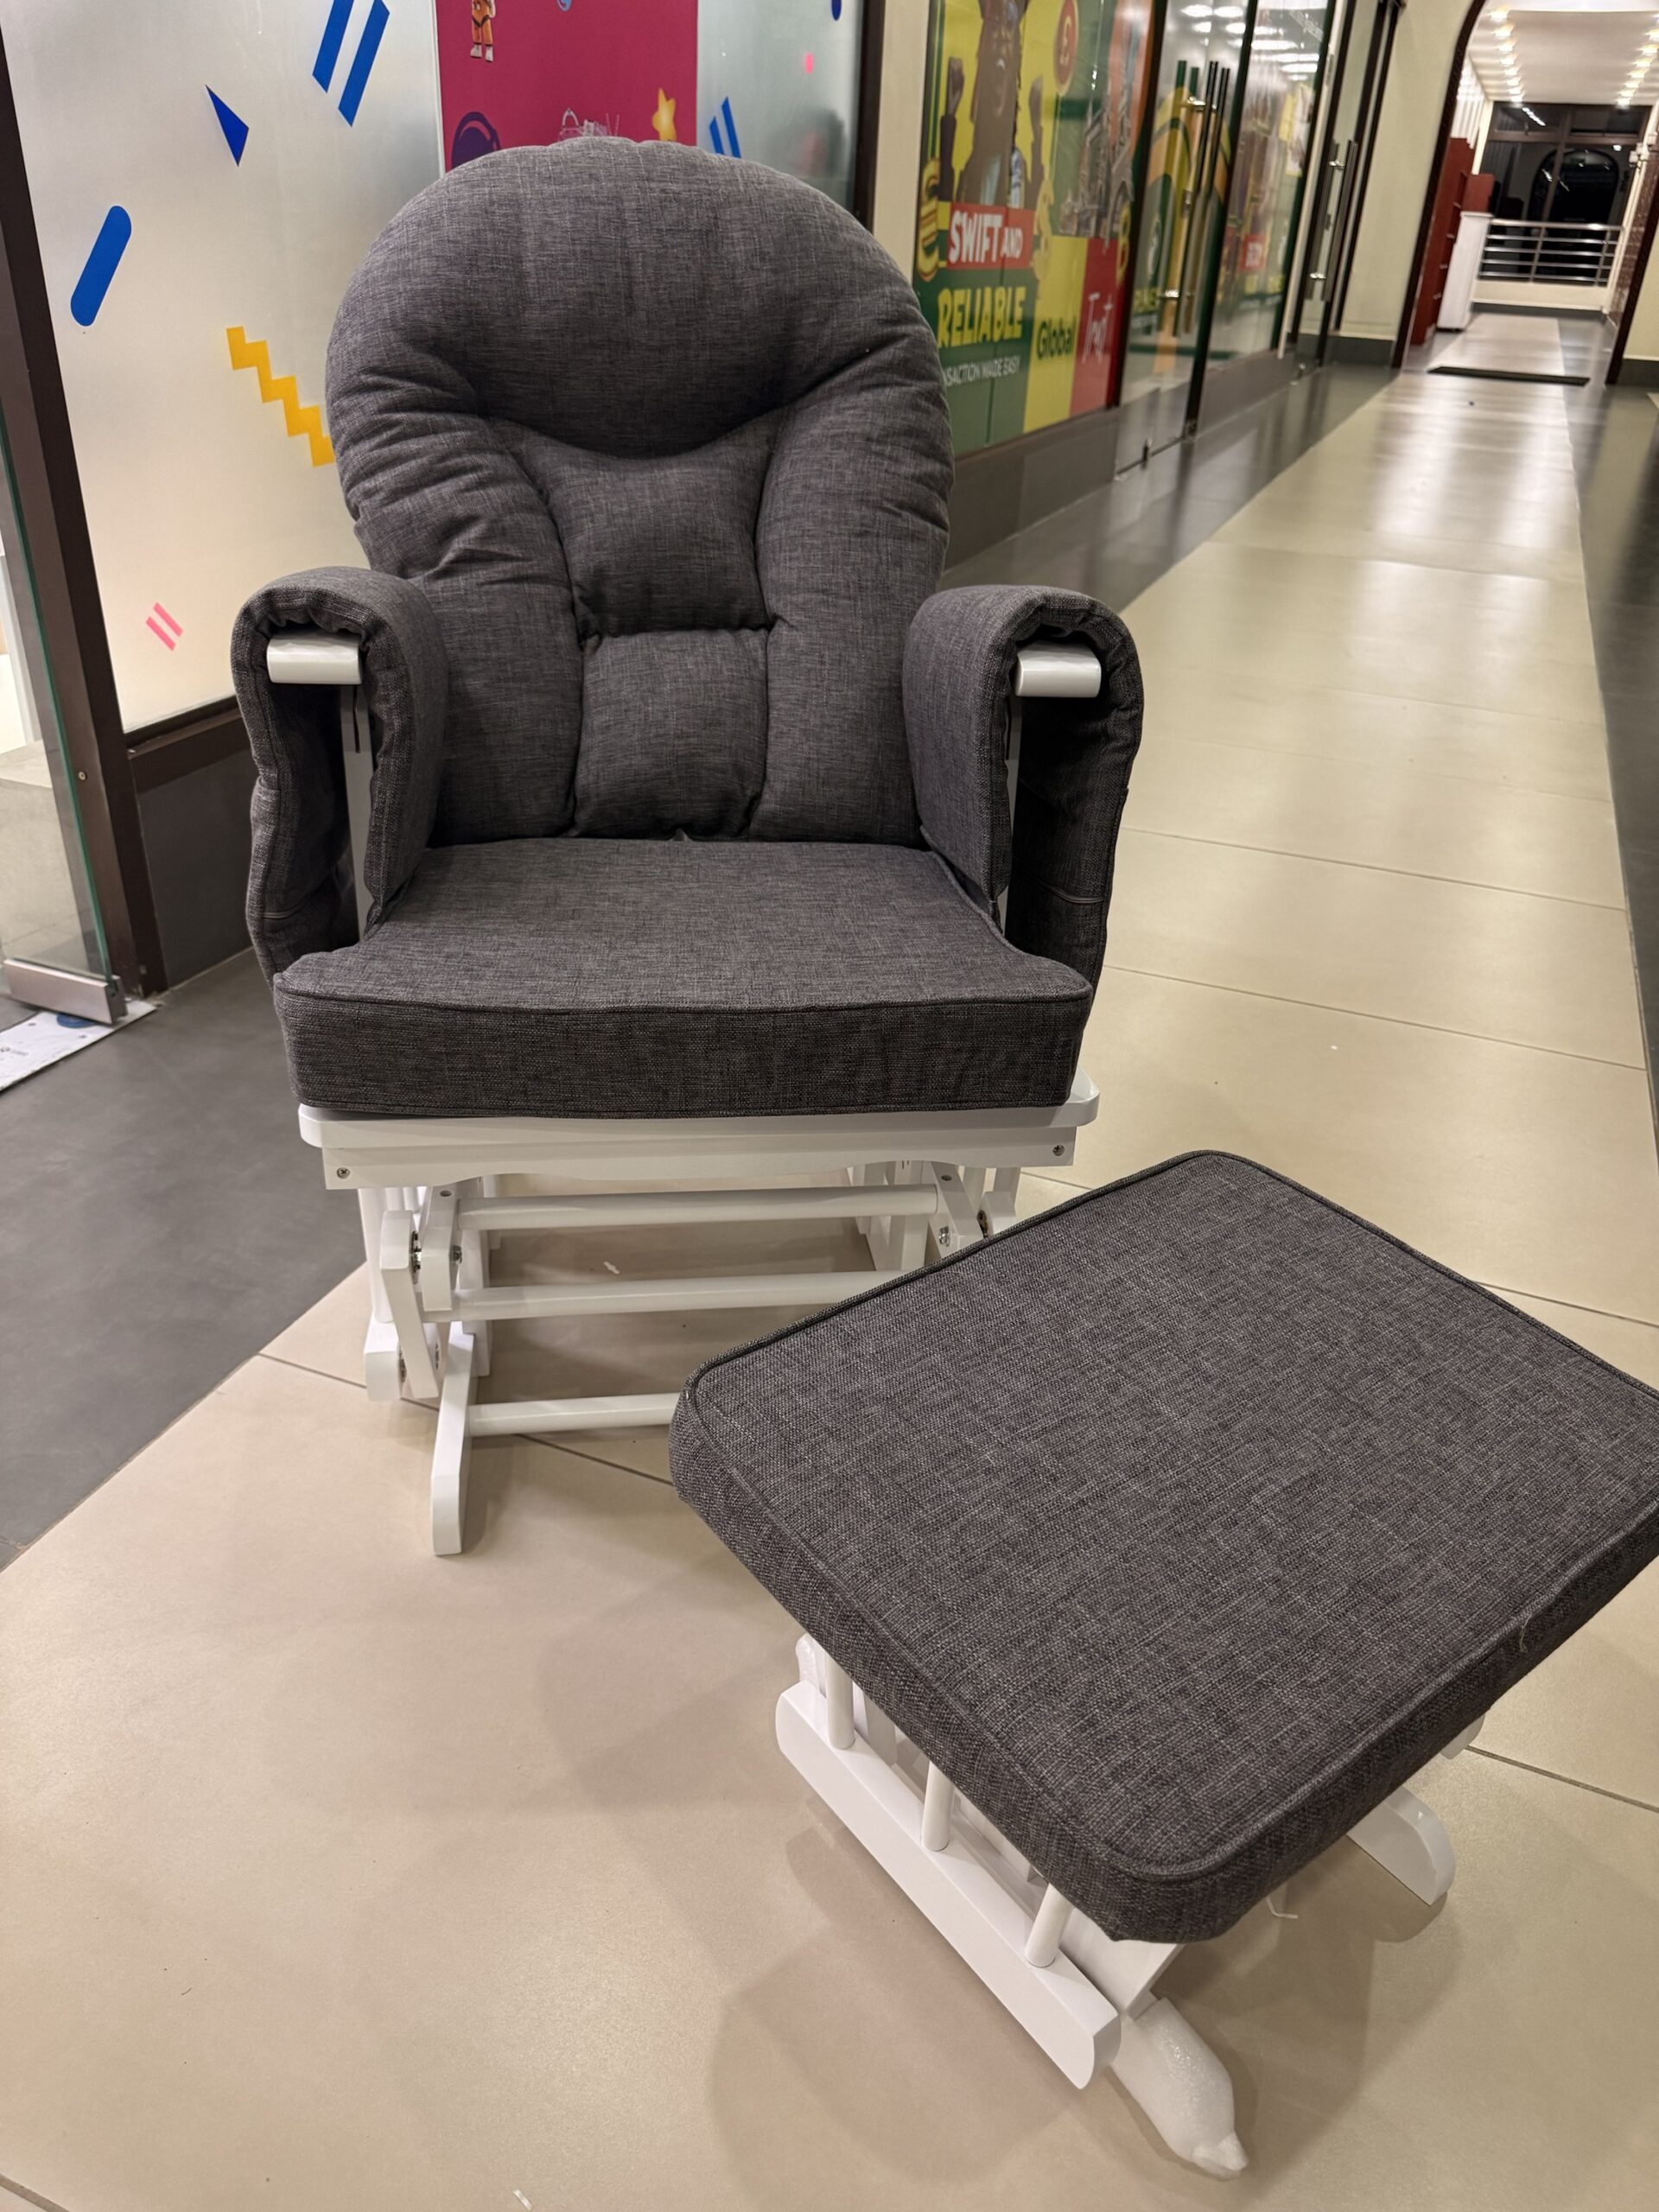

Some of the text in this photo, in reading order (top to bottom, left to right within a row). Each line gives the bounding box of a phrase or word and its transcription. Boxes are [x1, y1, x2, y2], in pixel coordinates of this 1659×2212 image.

[949, 210, 1023, 264] SWIFT AND
[938, 286, 1027, 348] RELIABLE
[1037, 317, 1077, 359] Global
[945, 364, 982, 386] SACTION
